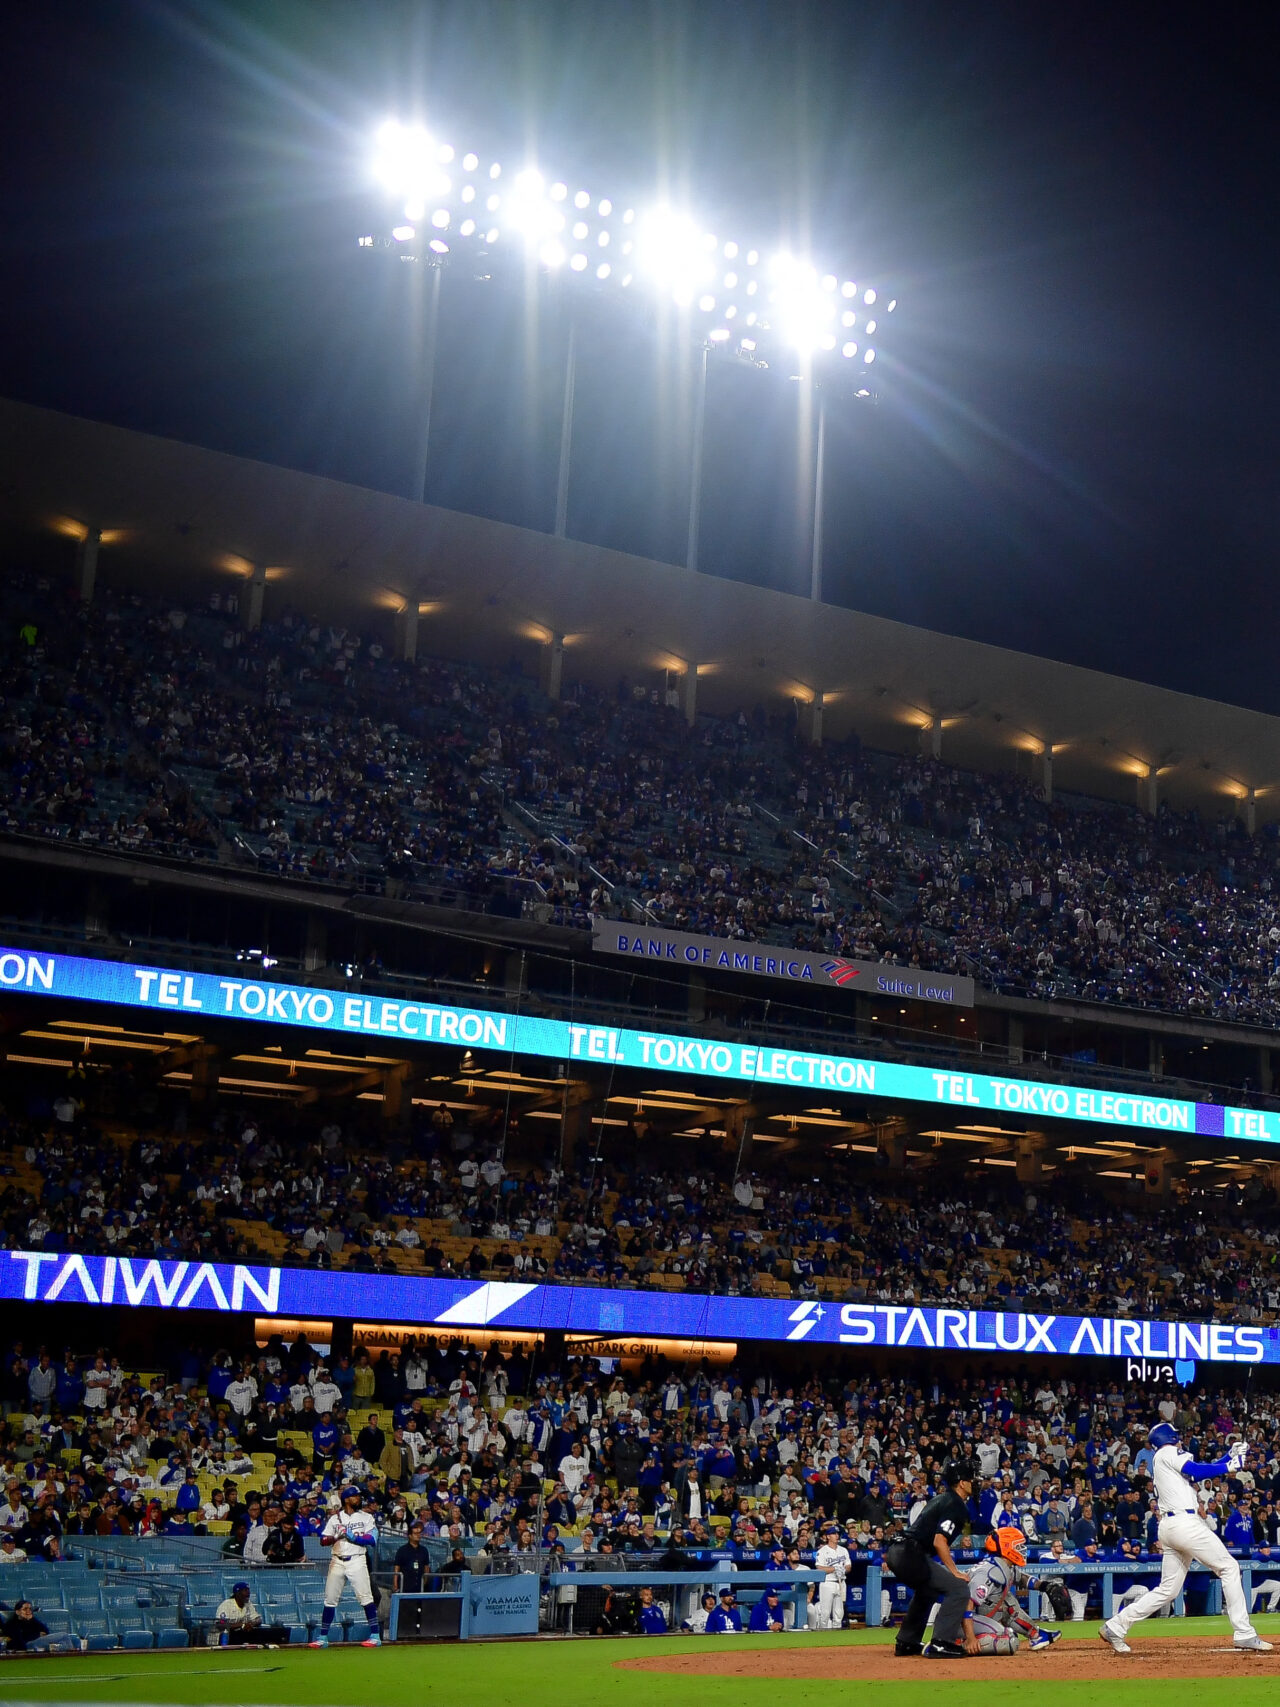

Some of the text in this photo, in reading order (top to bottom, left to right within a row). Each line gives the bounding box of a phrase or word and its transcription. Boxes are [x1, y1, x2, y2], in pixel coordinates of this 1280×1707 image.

[617, 934, 814, 980] BANK OF AMERICA
[135, 969, 508, 1046] TEL TOKYO ELECTRON
[877, 975, 954, 1001] Suite Level
[569, 1026, 876, 1091] TEL TOKYO ELECTRON
[932, 1073, 1189, 1129] TEL TOKYO ELECTRON
[1230, 1111, 1271, 1139] TEL
[11, 1251, 281, 1312] TAIWAN
[597, 1343, 627, 1354] PARK
[629, 1344, 658, 1356] GRILL
[839, 1304, 1264, 1362] STARLUX AIRLINES
[1127, 1357, 1174, 1383] blue
[825, 1555, 847, 1566] Dodgers
